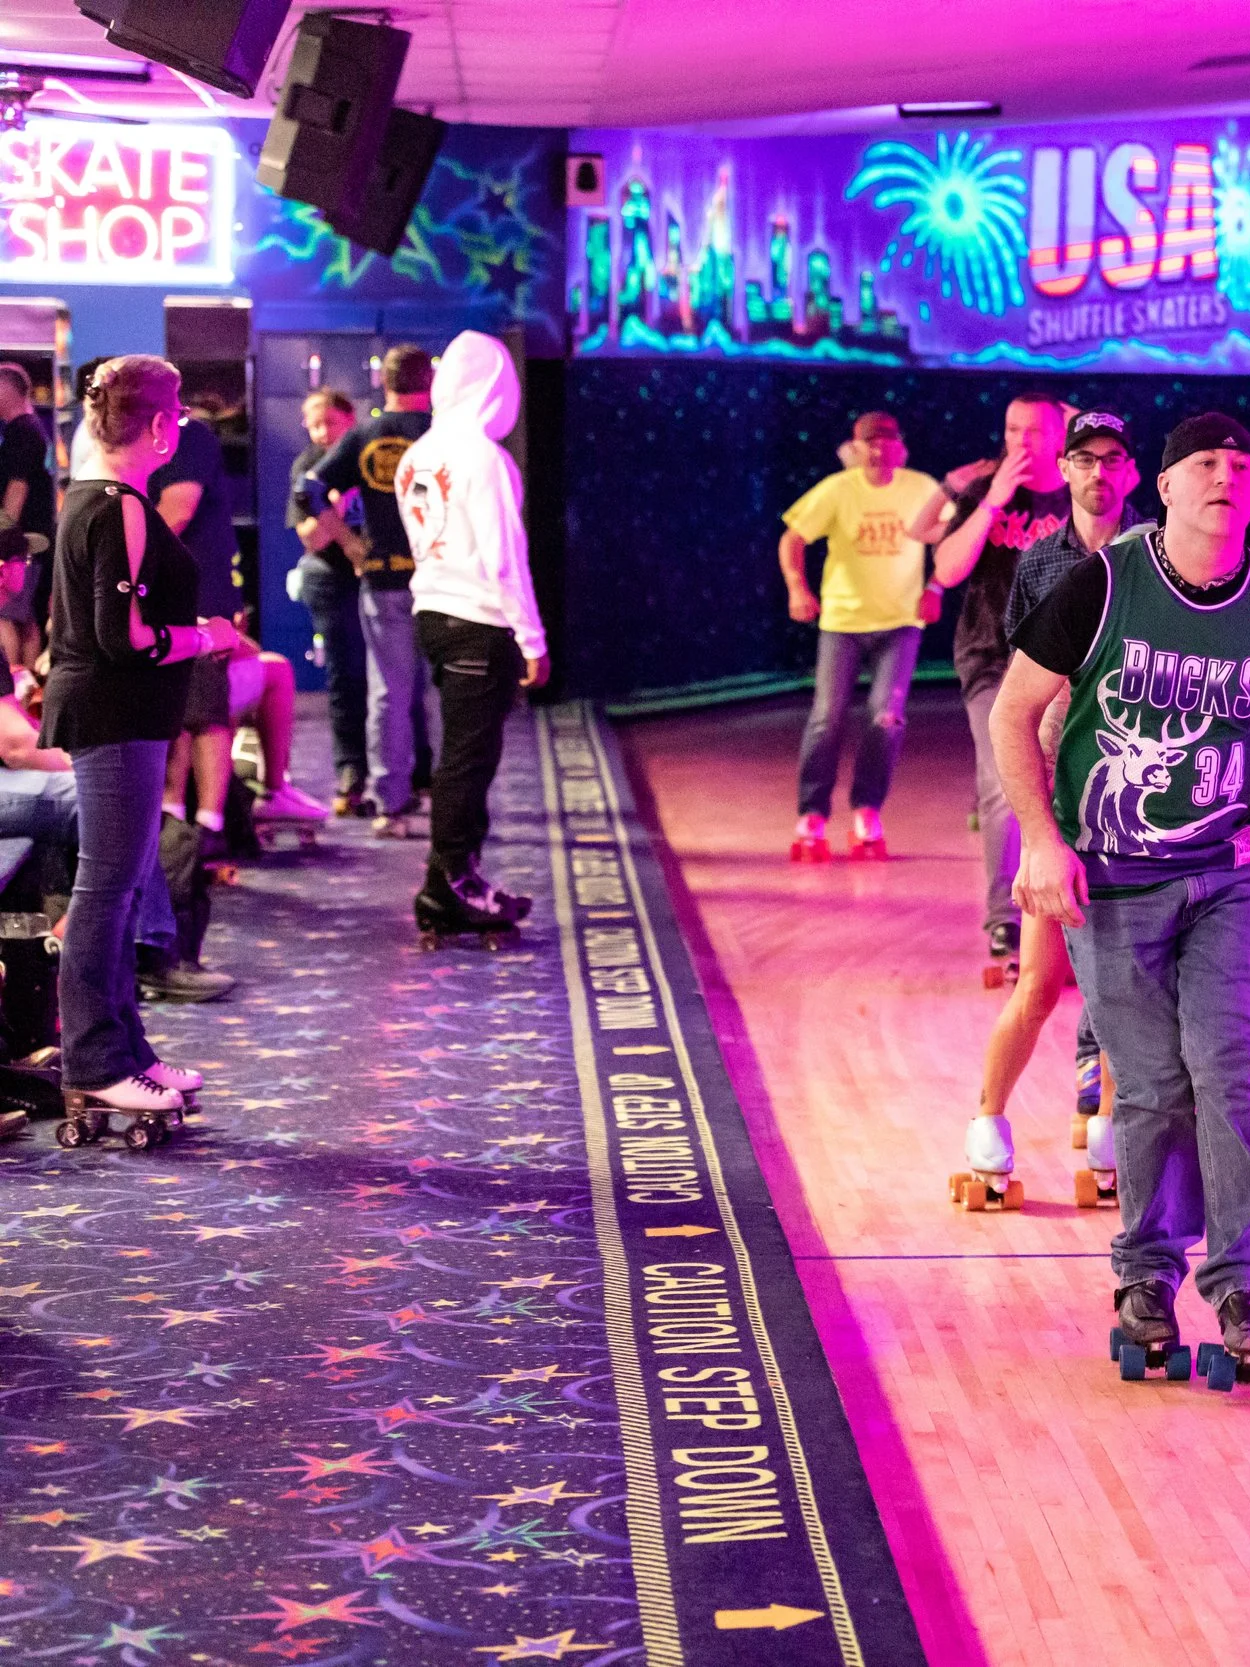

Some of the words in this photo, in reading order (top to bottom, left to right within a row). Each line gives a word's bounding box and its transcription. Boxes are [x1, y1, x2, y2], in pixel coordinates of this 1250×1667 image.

[0, 129, 210, 204] SKATE
[5, 202, 206, 268] SHOP
[1028, 143, 1219, 297] USA
[1028, 303, 1125, 347] SHUFFLE
[1131, 295, 1227, 333] SKATERS
[1192, 741, 1244, 807] 34
[608, 1073, 676, 1091] UP
[612, 1095, 687, 1130] STEP
[620, 1136, 703, 1203] CAUTION
[642, 1262, 742, 1354] CAUTION
[657, 1366, 762, 1430] STEP
[671, 1445, 788, 1544] DOWN
